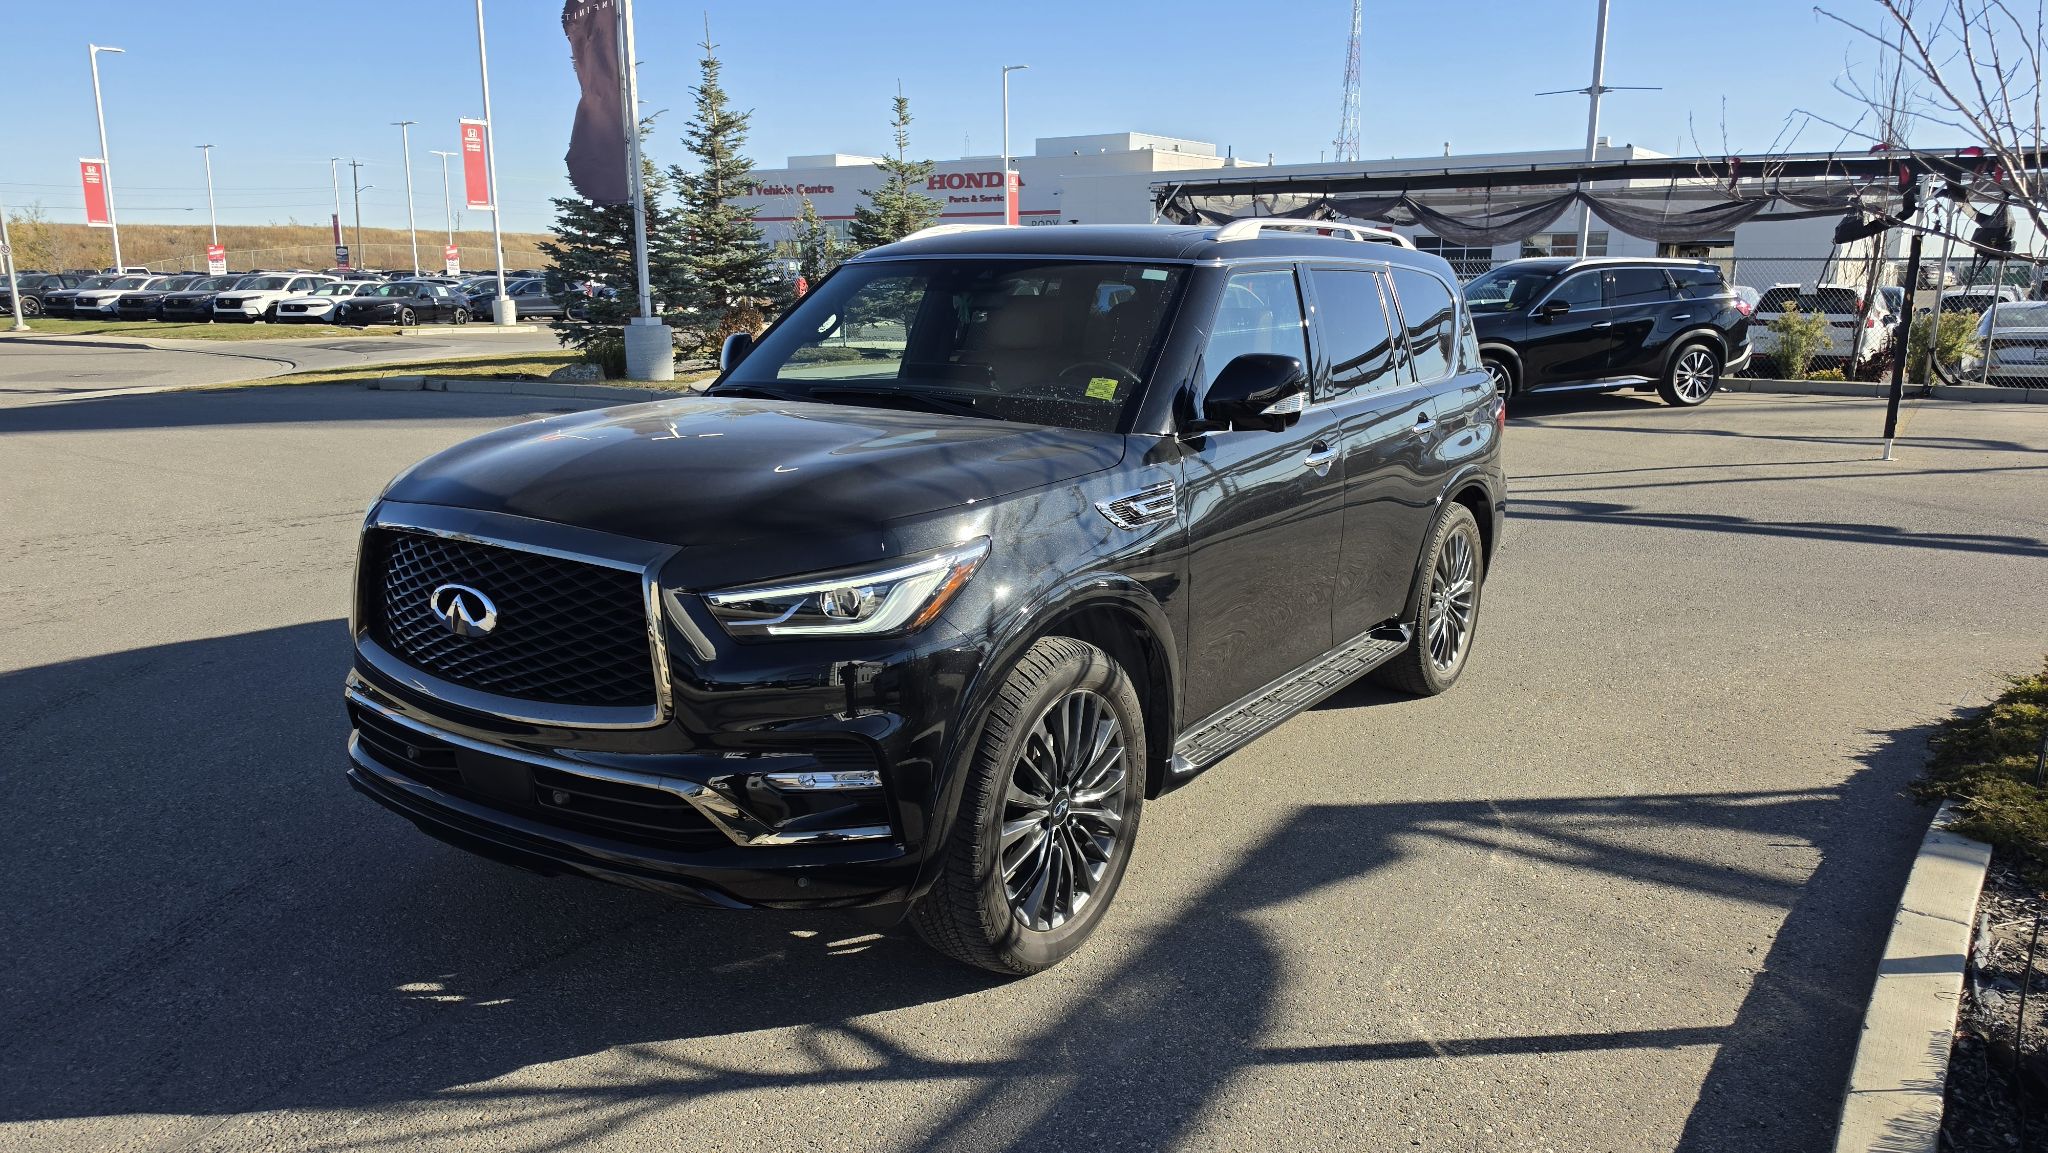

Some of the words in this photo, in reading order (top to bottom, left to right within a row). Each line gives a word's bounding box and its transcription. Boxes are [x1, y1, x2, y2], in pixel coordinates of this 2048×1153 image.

[755, 184, 794, 196] Vehicle
[796, 183, 834, 194] Centre
[948, 195, 970, 203] Parts
[971, 194, 978, 203] &
[979, 193, 1004, 203] Servic
